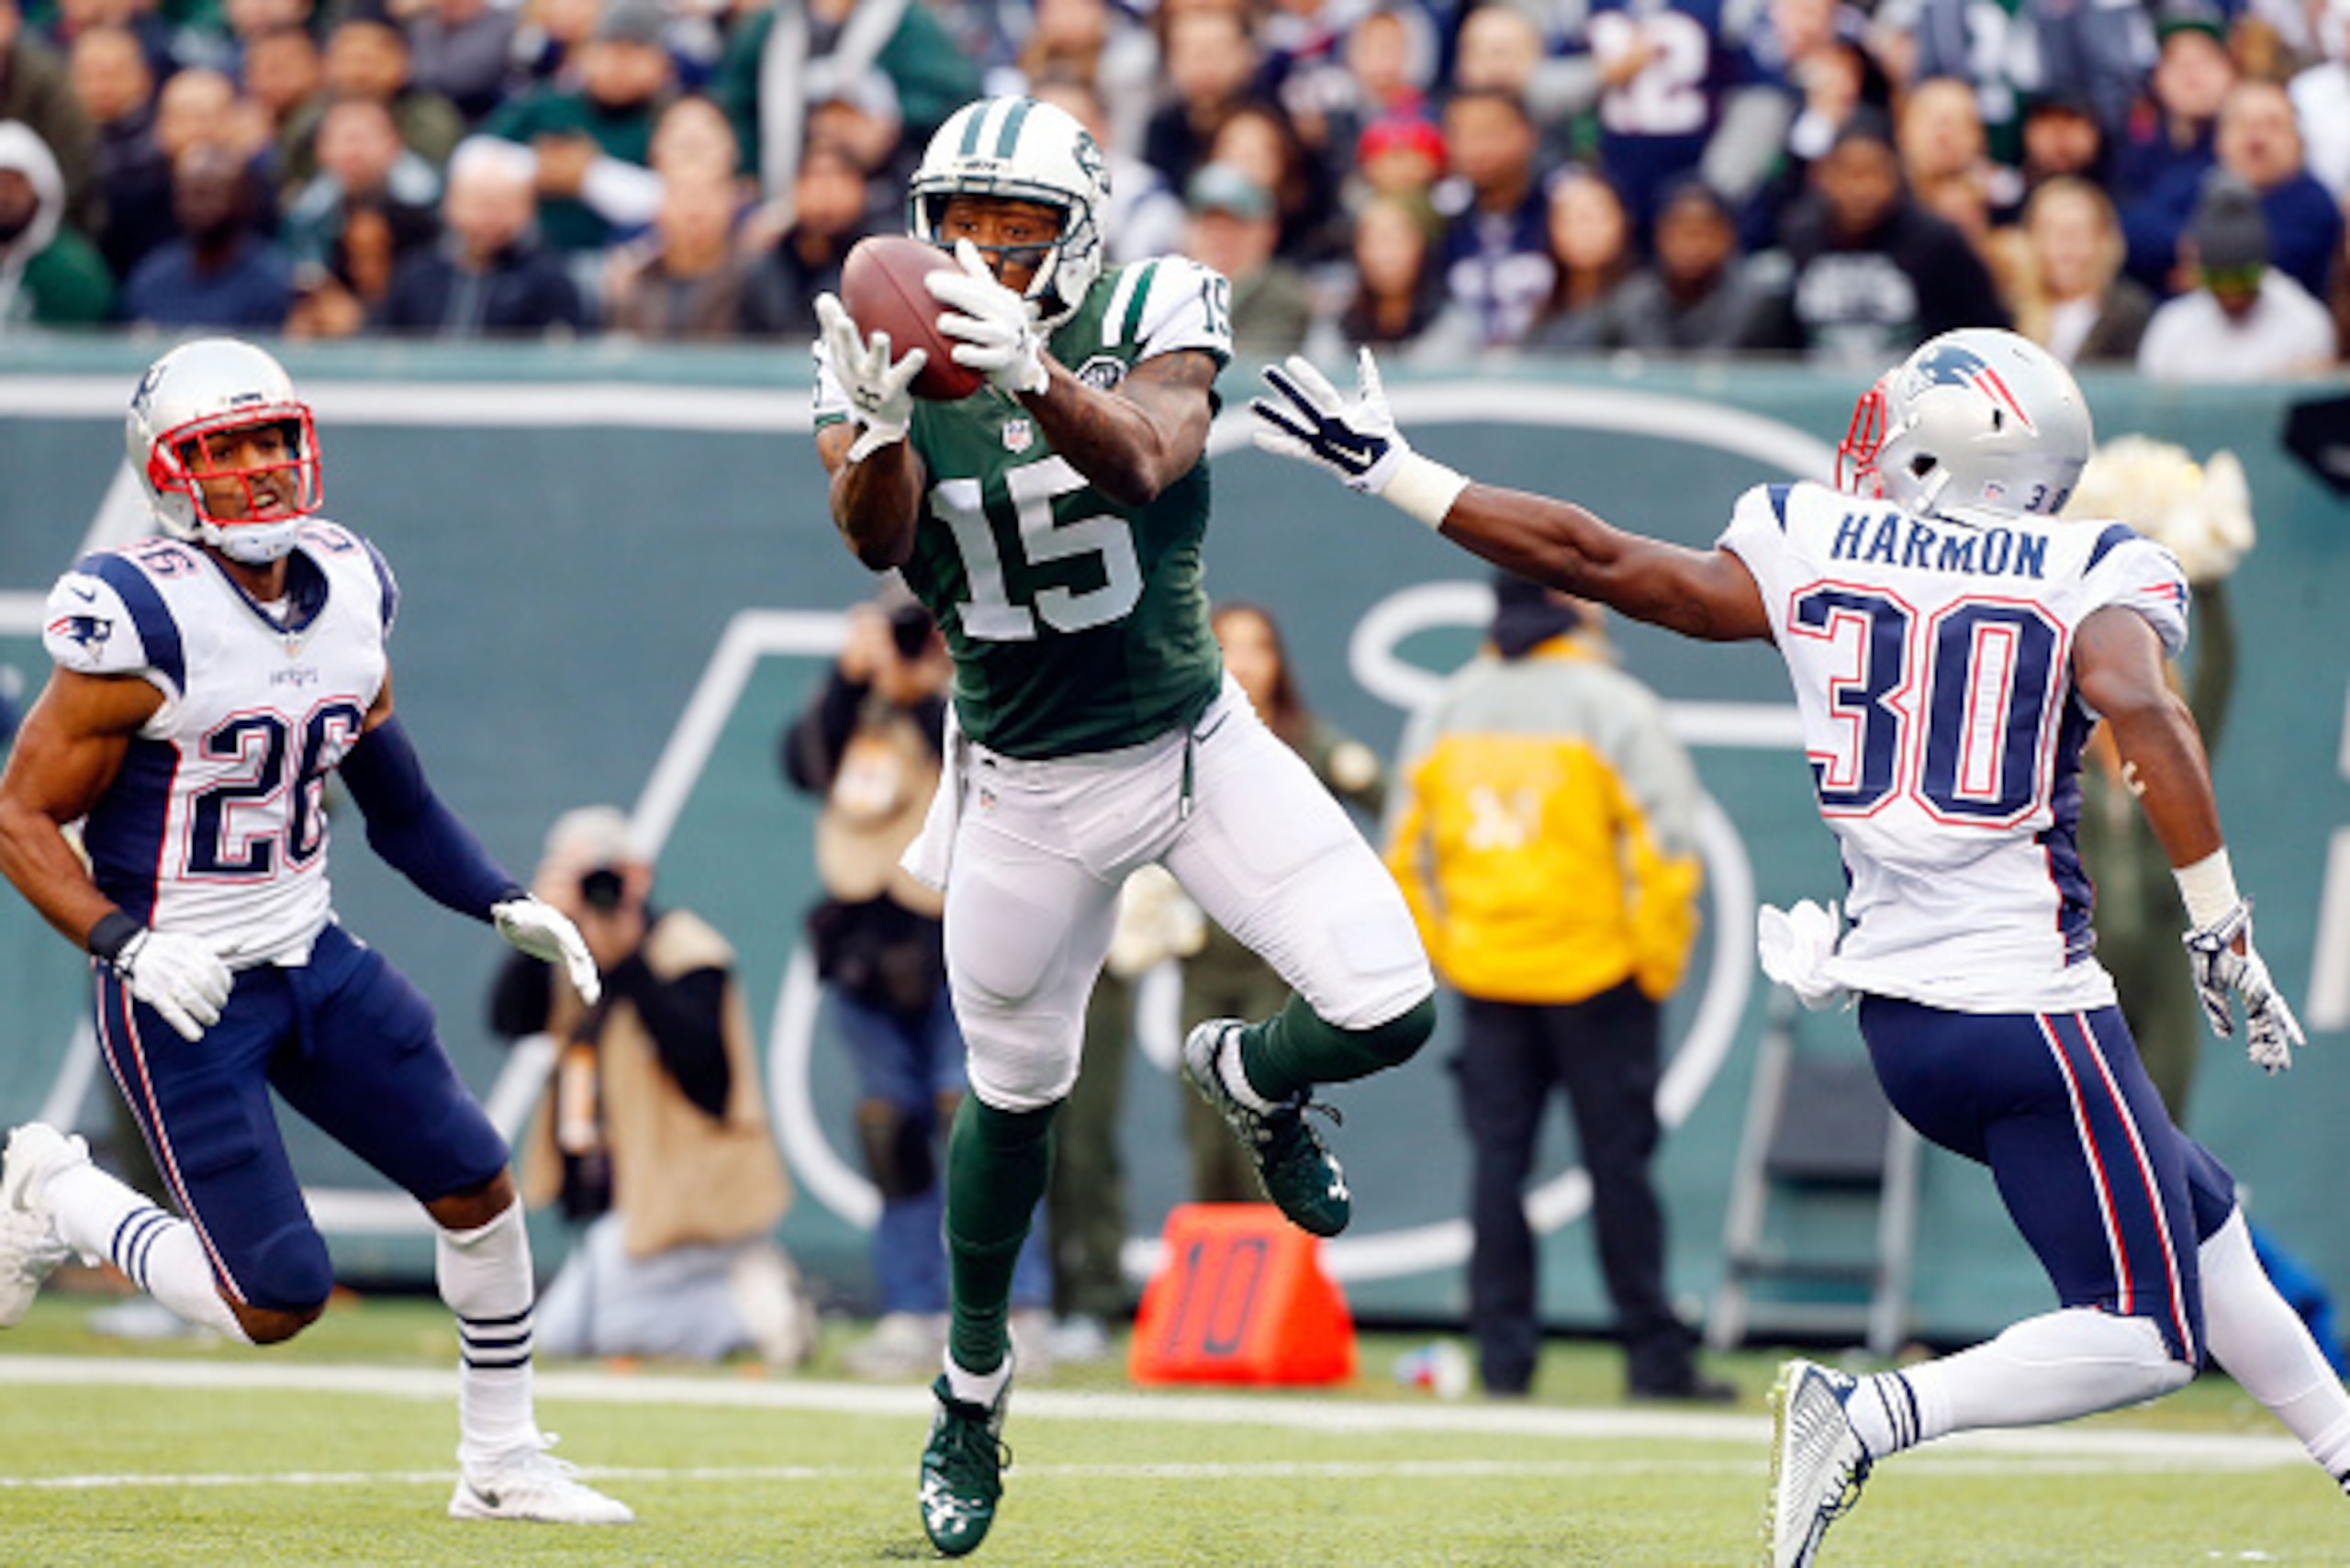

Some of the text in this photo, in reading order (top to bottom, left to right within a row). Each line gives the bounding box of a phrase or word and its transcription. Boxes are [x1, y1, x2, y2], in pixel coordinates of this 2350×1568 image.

[927, 454, 1146, 641] 15
[1830, 512, 2049, 580] HARMON
[176, 695, 369, 884] 26
[1787, 579, 2067, 830] 30
[1167, 1238, 1268, 1355] 10
